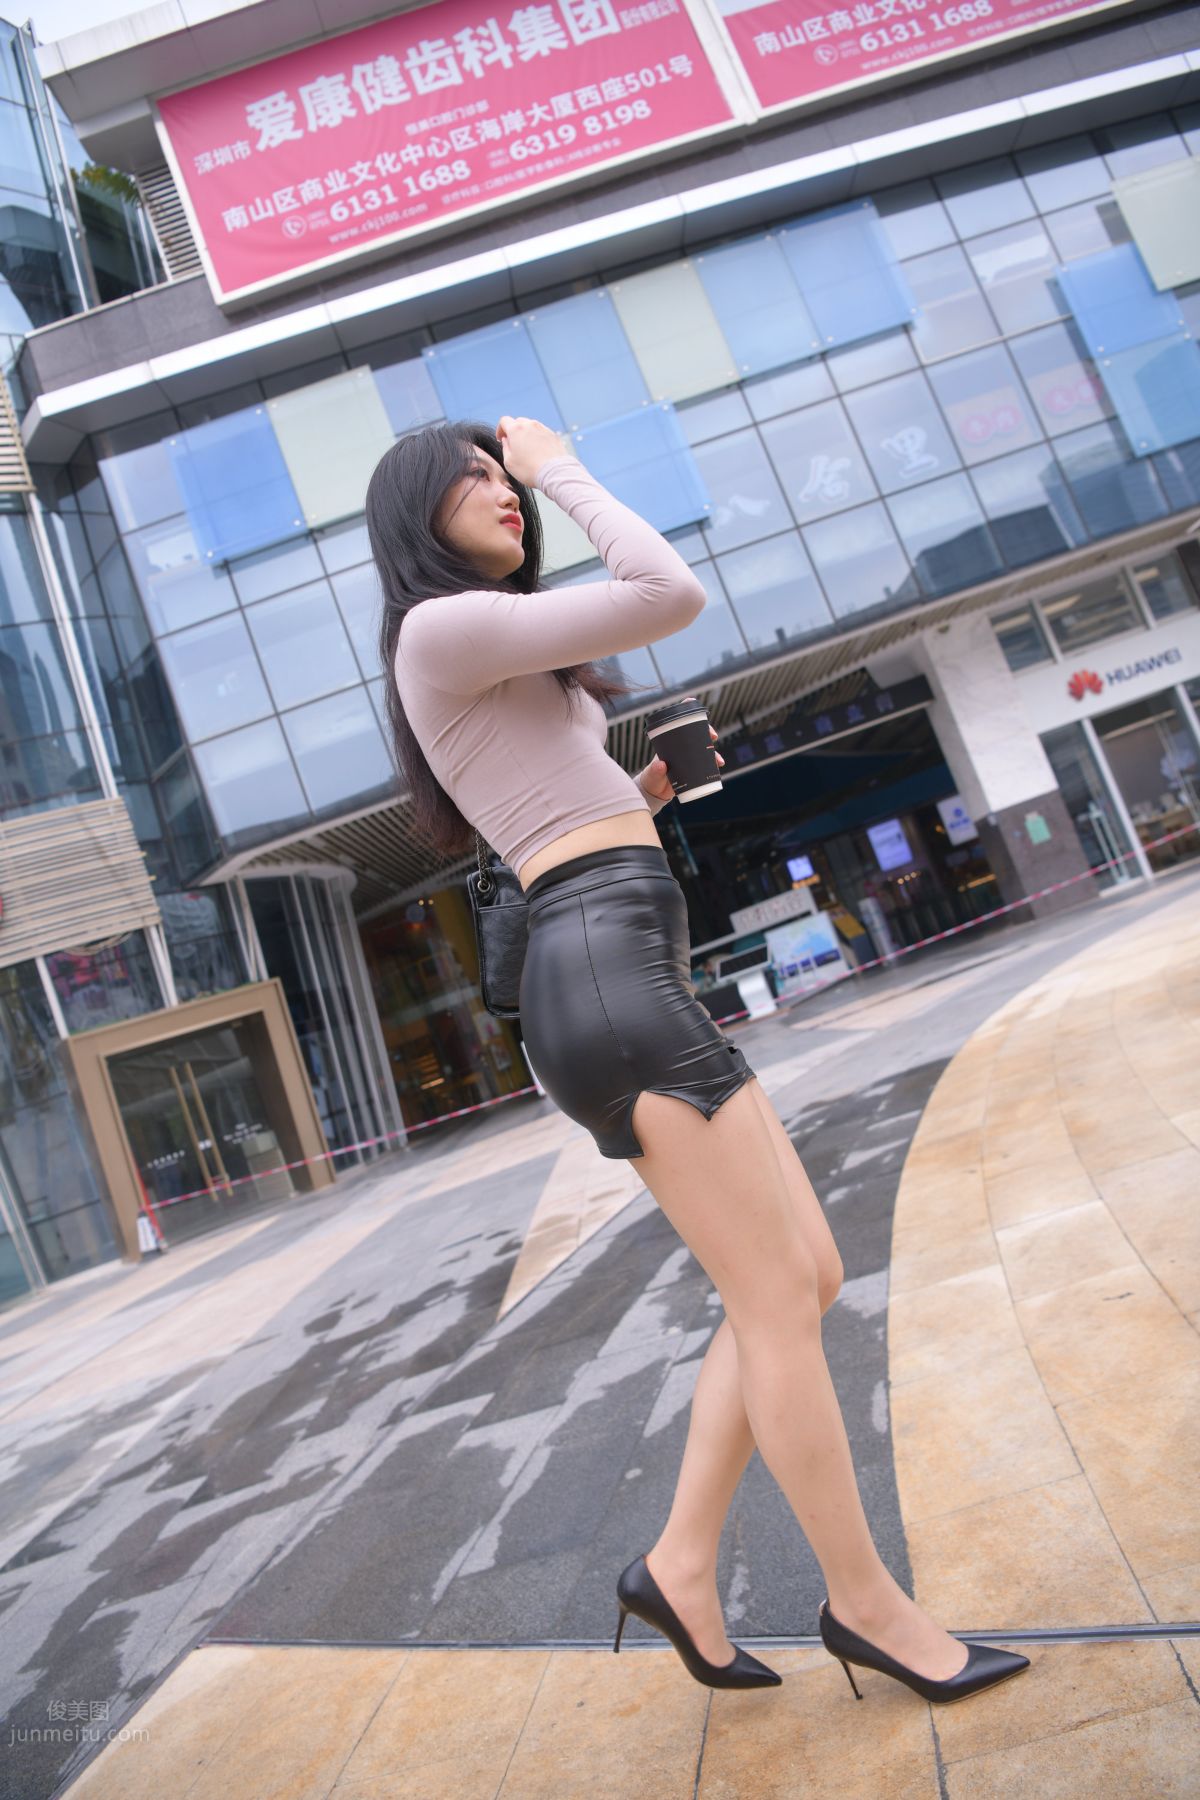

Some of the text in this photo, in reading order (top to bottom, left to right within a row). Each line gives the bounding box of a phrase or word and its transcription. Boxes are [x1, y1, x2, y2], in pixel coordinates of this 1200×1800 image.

[753, 0, 943, 57] 南山区商业文化
[860, 19, 926, 52] 6131
[928, 0, 994, 32] 1688
[193, 139, 252, 175] 深圳市
[246, 0, 621, 152] 爱康健齿科集团
[221, 53, 694, 233] 南山区商业文化中心区海岸大厦西座501号
[330, 184, 399, 223] 6131
[403, 159, 472, 198] 1688
[508, 124, 578, 162] 6319
[583, 98, 652, 138] 8198
[1106, 647, 1183, 687] HUAWEI
